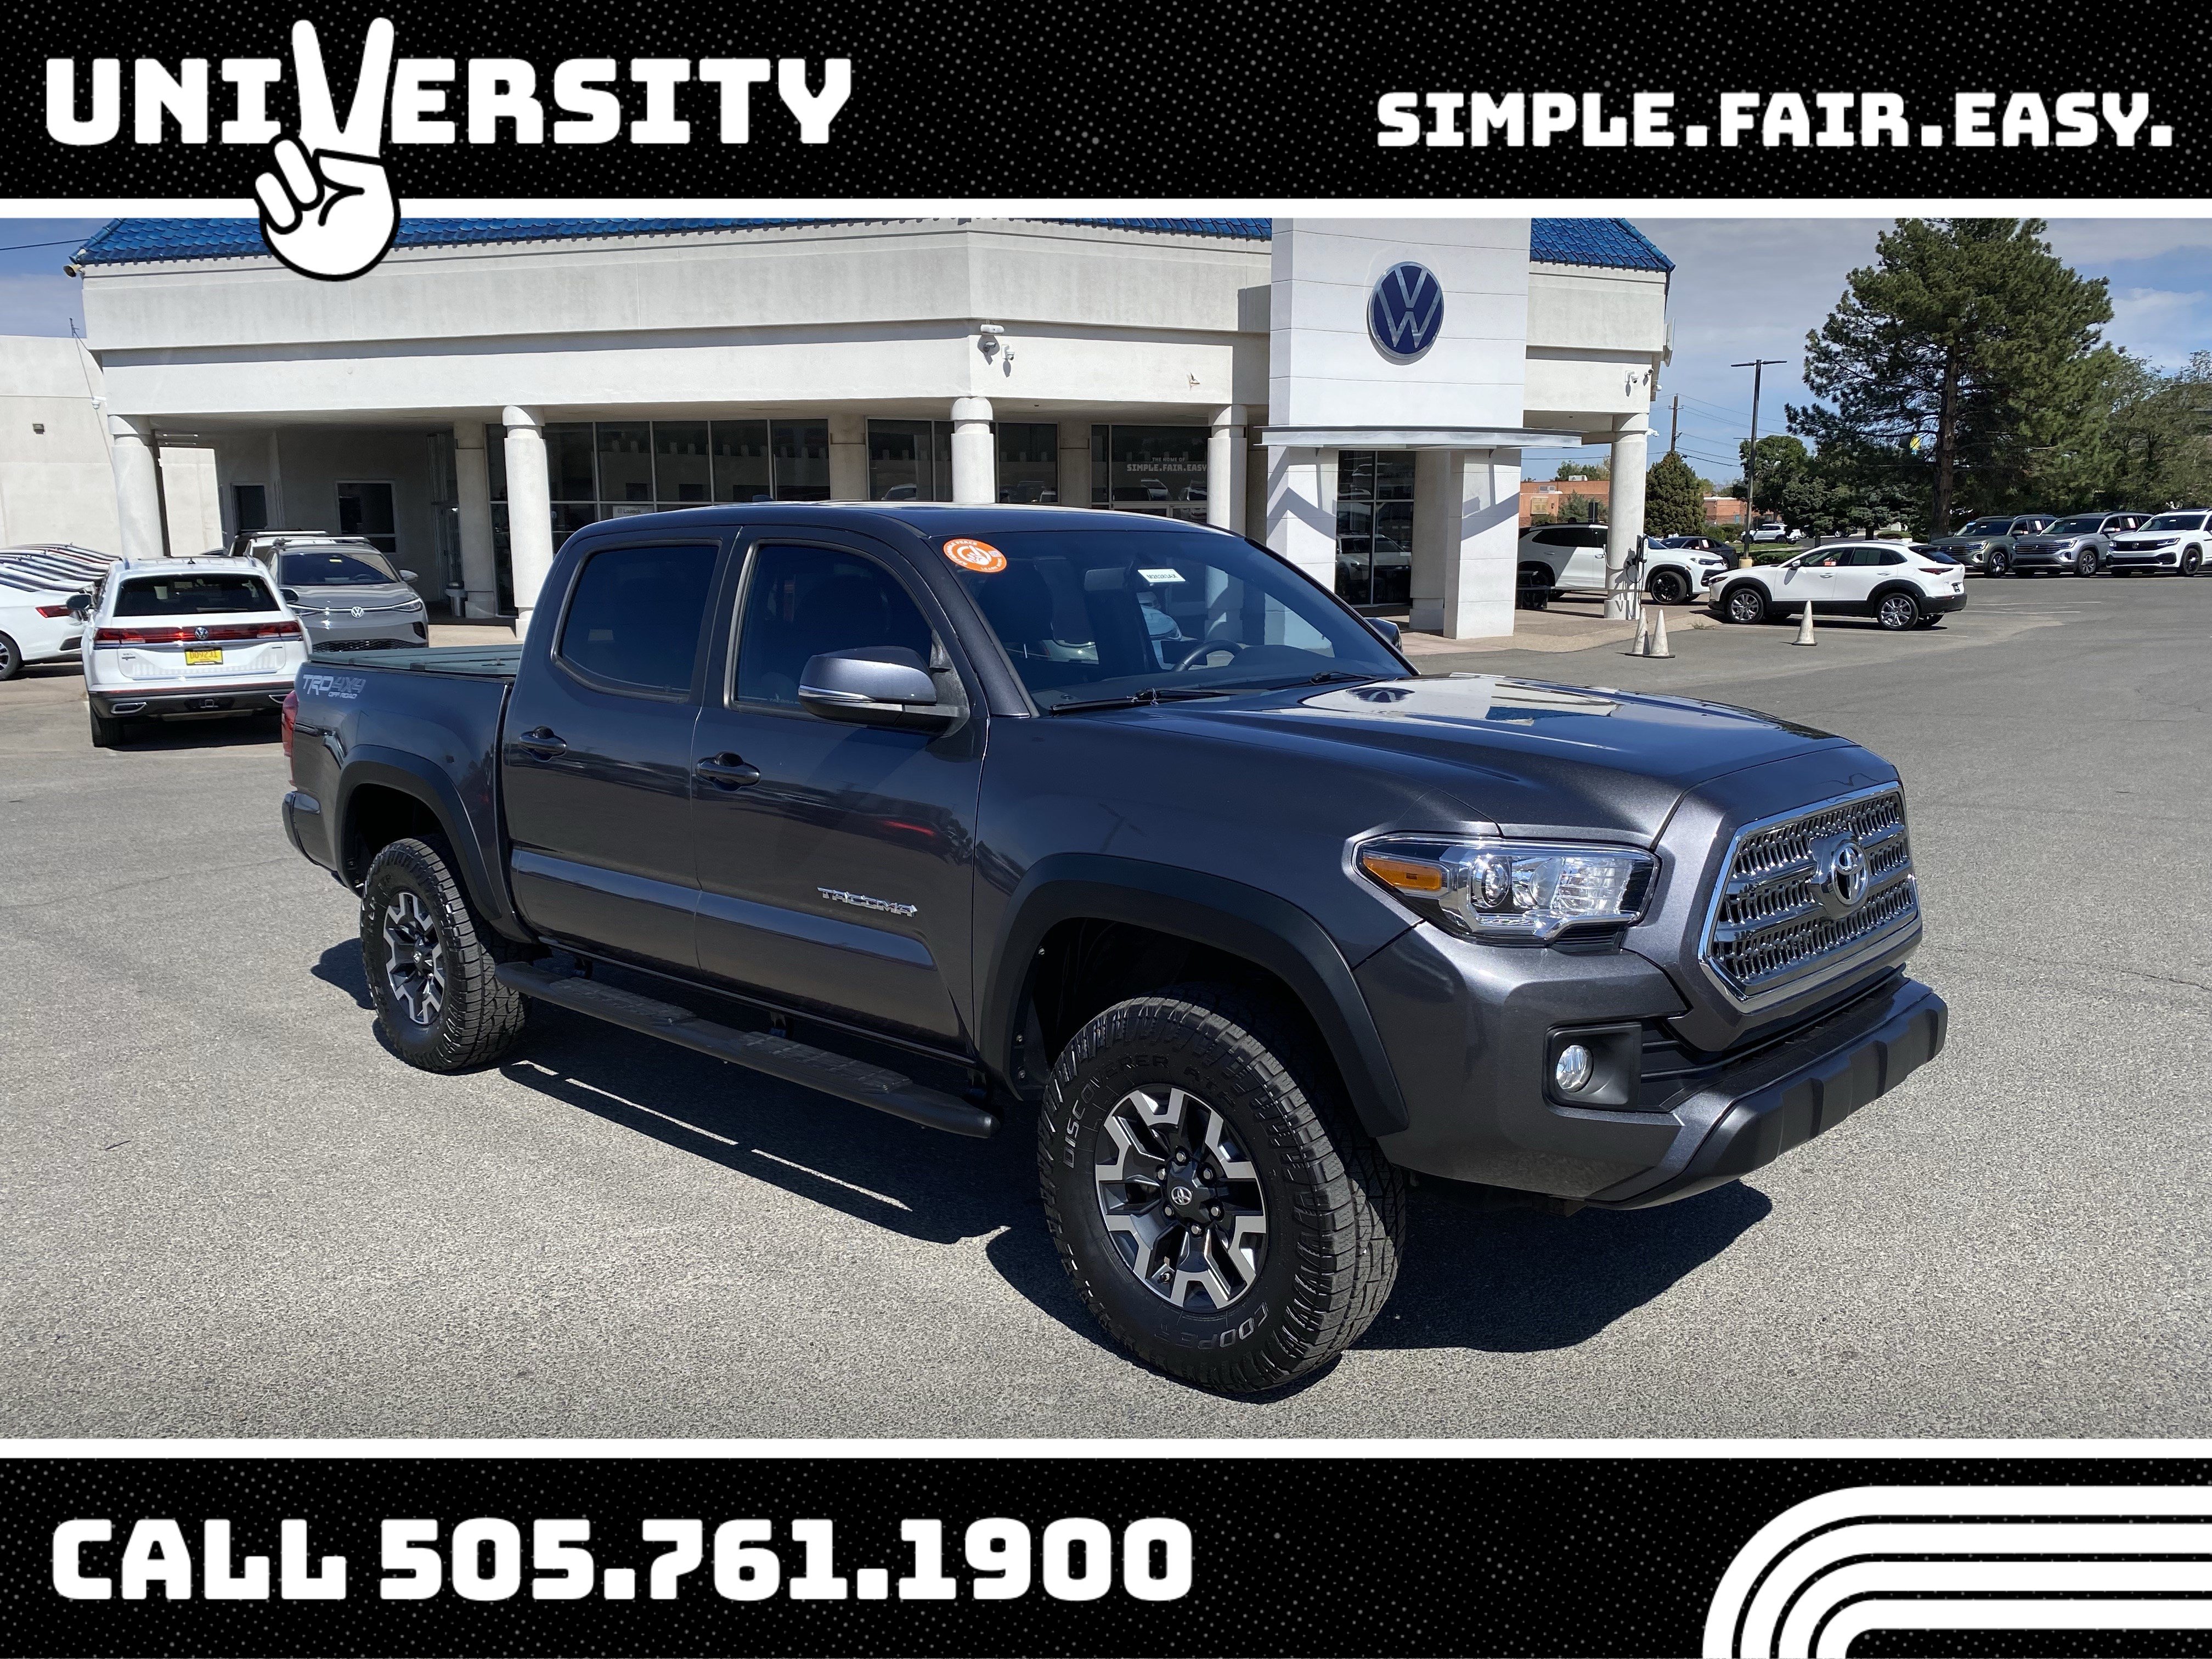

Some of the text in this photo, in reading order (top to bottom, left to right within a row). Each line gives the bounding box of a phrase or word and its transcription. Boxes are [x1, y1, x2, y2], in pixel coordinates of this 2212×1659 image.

[1369, 262, 1443, 359] VW
[303, 674, 334, 696] TRD
[817, 887, 918, 918] TACOMA
[1063, 1052, 1170, 1169] DISCOVERER
